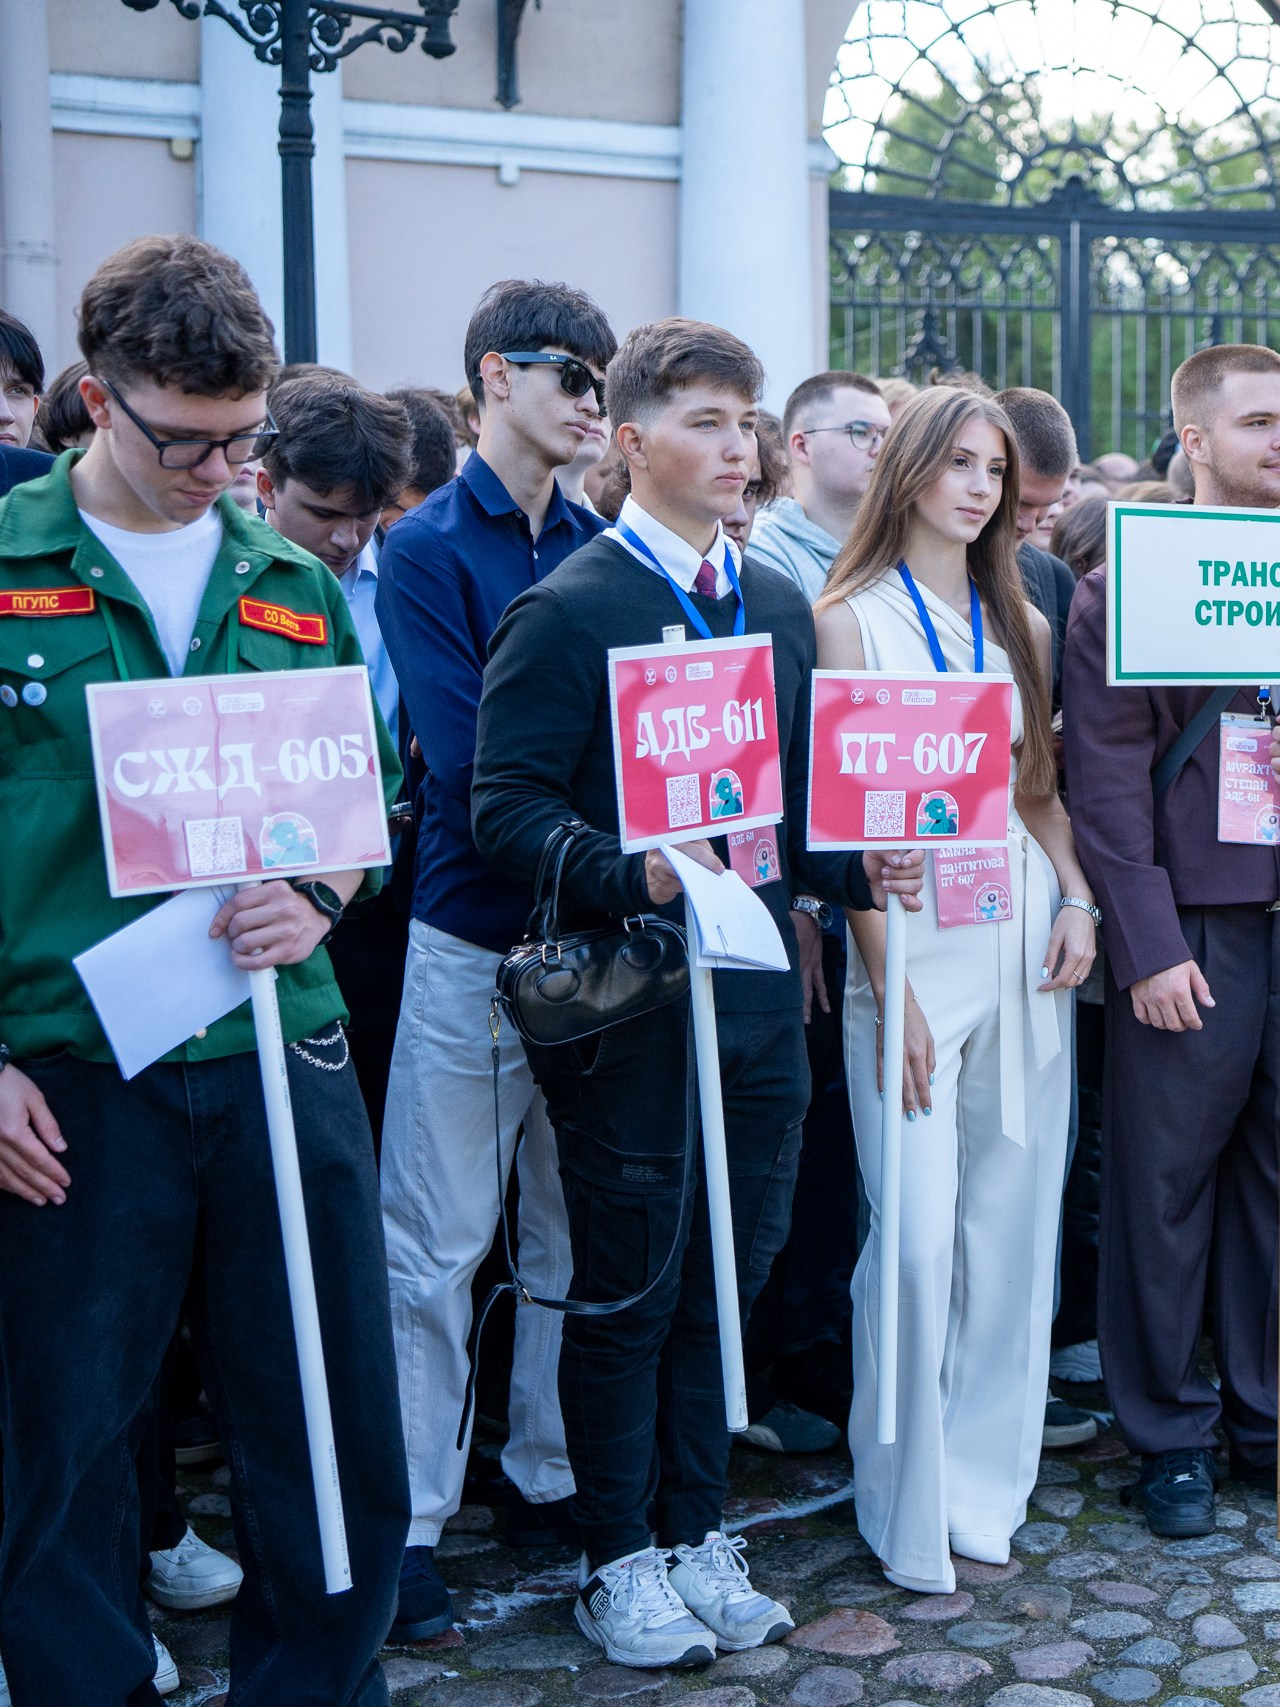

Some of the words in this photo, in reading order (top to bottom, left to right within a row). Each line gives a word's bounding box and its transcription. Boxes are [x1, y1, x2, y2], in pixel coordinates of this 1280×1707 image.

[12, 595, 60, 609] ПГУПС
[636, 697, 766, 766] АДБ-611
[113, 733, 368, 799] СЖД-605
[839, 732, 988, 775] ПТ-607
[1226, 761, 1276, 776] МУРАХТ
[1225, 778, 1268, 791] СТЕПАН
